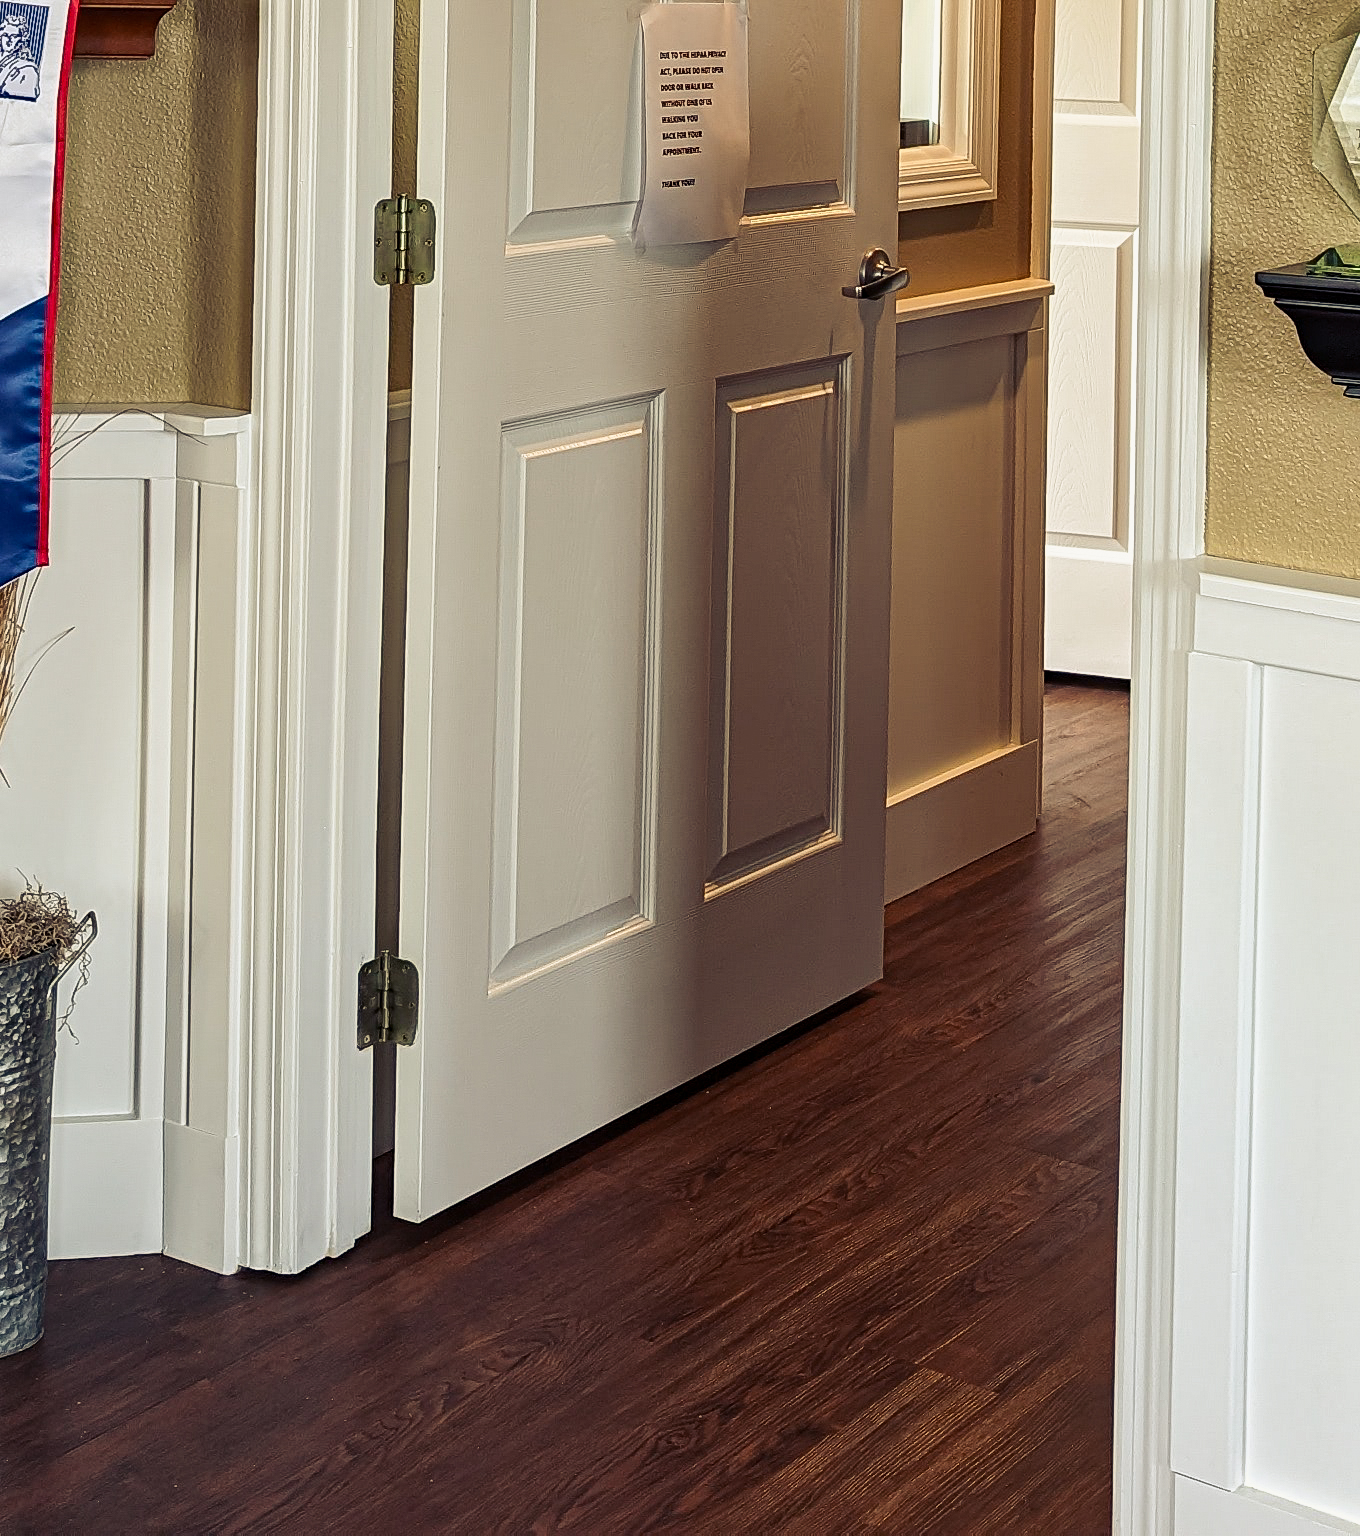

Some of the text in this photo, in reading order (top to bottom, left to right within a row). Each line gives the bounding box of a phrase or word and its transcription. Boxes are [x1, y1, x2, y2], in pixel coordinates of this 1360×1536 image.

[671, 51, 678, 59] TO
[692, 66, 700, 74] DO
[661, 83, 675, 91] DOOR
[676, 83, 684, 91] OR
